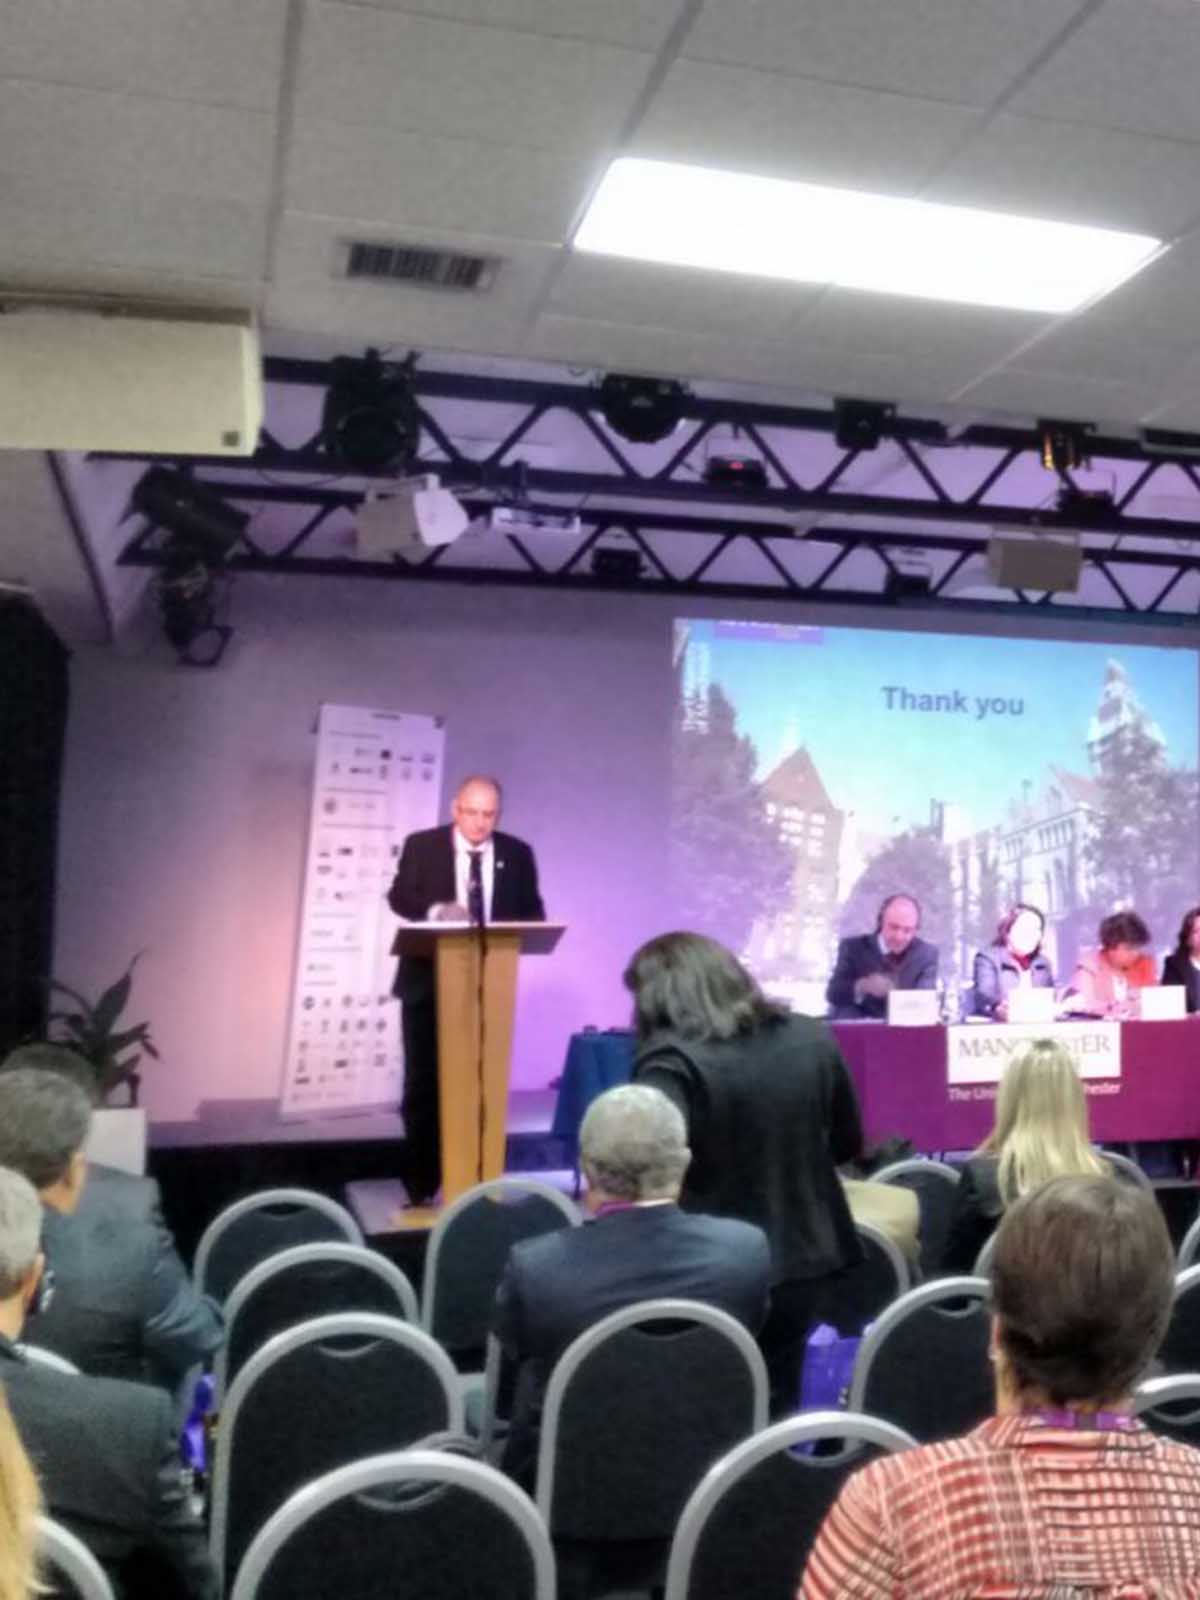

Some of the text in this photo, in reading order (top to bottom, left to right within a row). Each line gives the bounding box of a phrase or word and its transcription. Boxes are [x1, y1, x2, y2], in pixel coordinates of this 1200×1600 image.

[881, 686, 1024, 721] Thank you
[958, 1034, 1111, 1058] MANSTER
[948, 1087, 970, 1101] The
